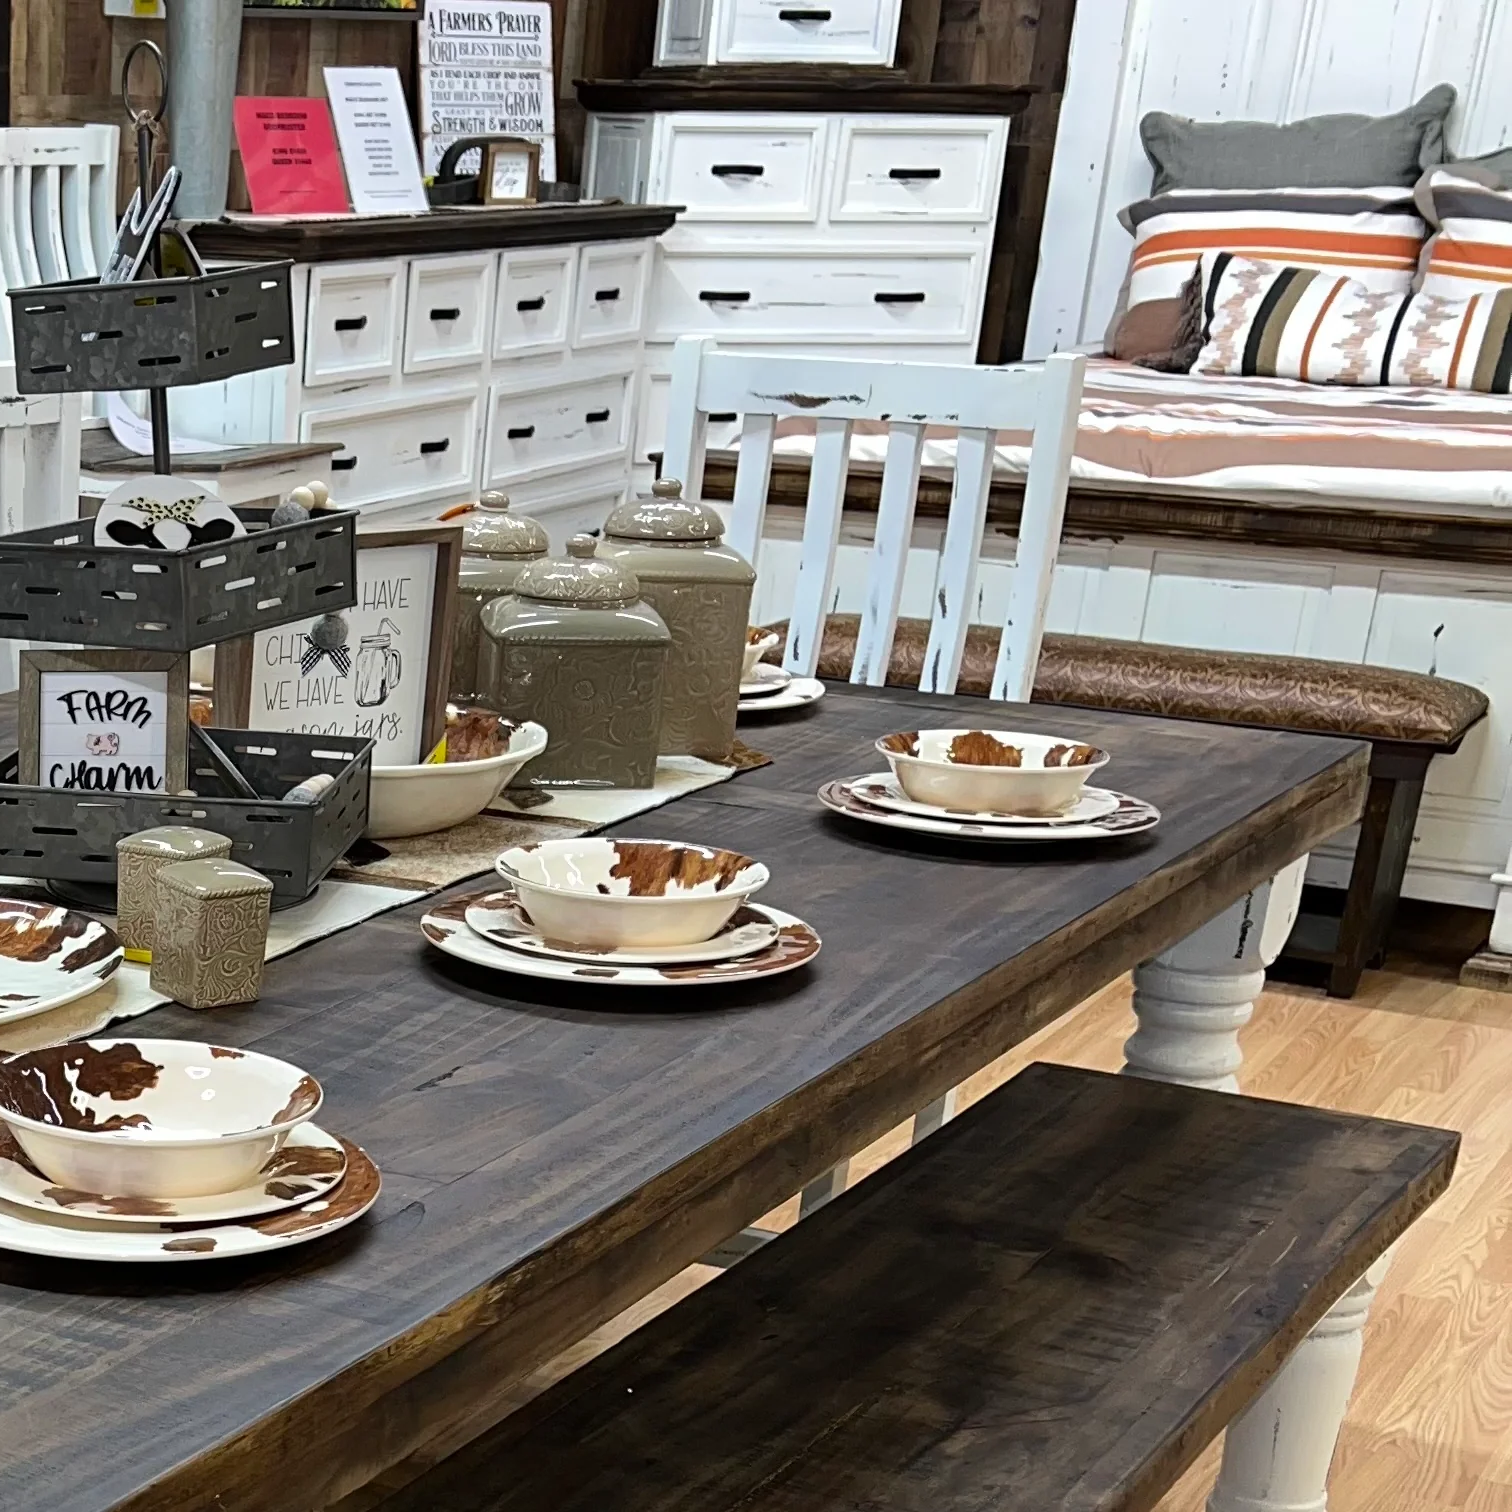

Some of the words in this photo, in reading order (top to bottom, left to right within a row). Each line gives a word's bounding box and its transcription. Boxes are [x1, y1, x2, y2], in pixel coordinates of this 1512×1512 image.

[428, 11, 436, 30] A
[496, 11, 541, 36] PRAYER
[459, 42, 489, 56] BLESS
[492, 42, 514, 57] THIS
[516, 42, 542, 59] LAND
[505, 92, 543, 116] GROW
[431, 110, 485, 134] STRENGTH
[488, 116, 497, 131] &
[498, 118, 544, 132] WISDOM
[363, 578, 411, 612] HAVE
[264, 681, 291, 711] WE
[296, 676, 346, 709] HAVE
